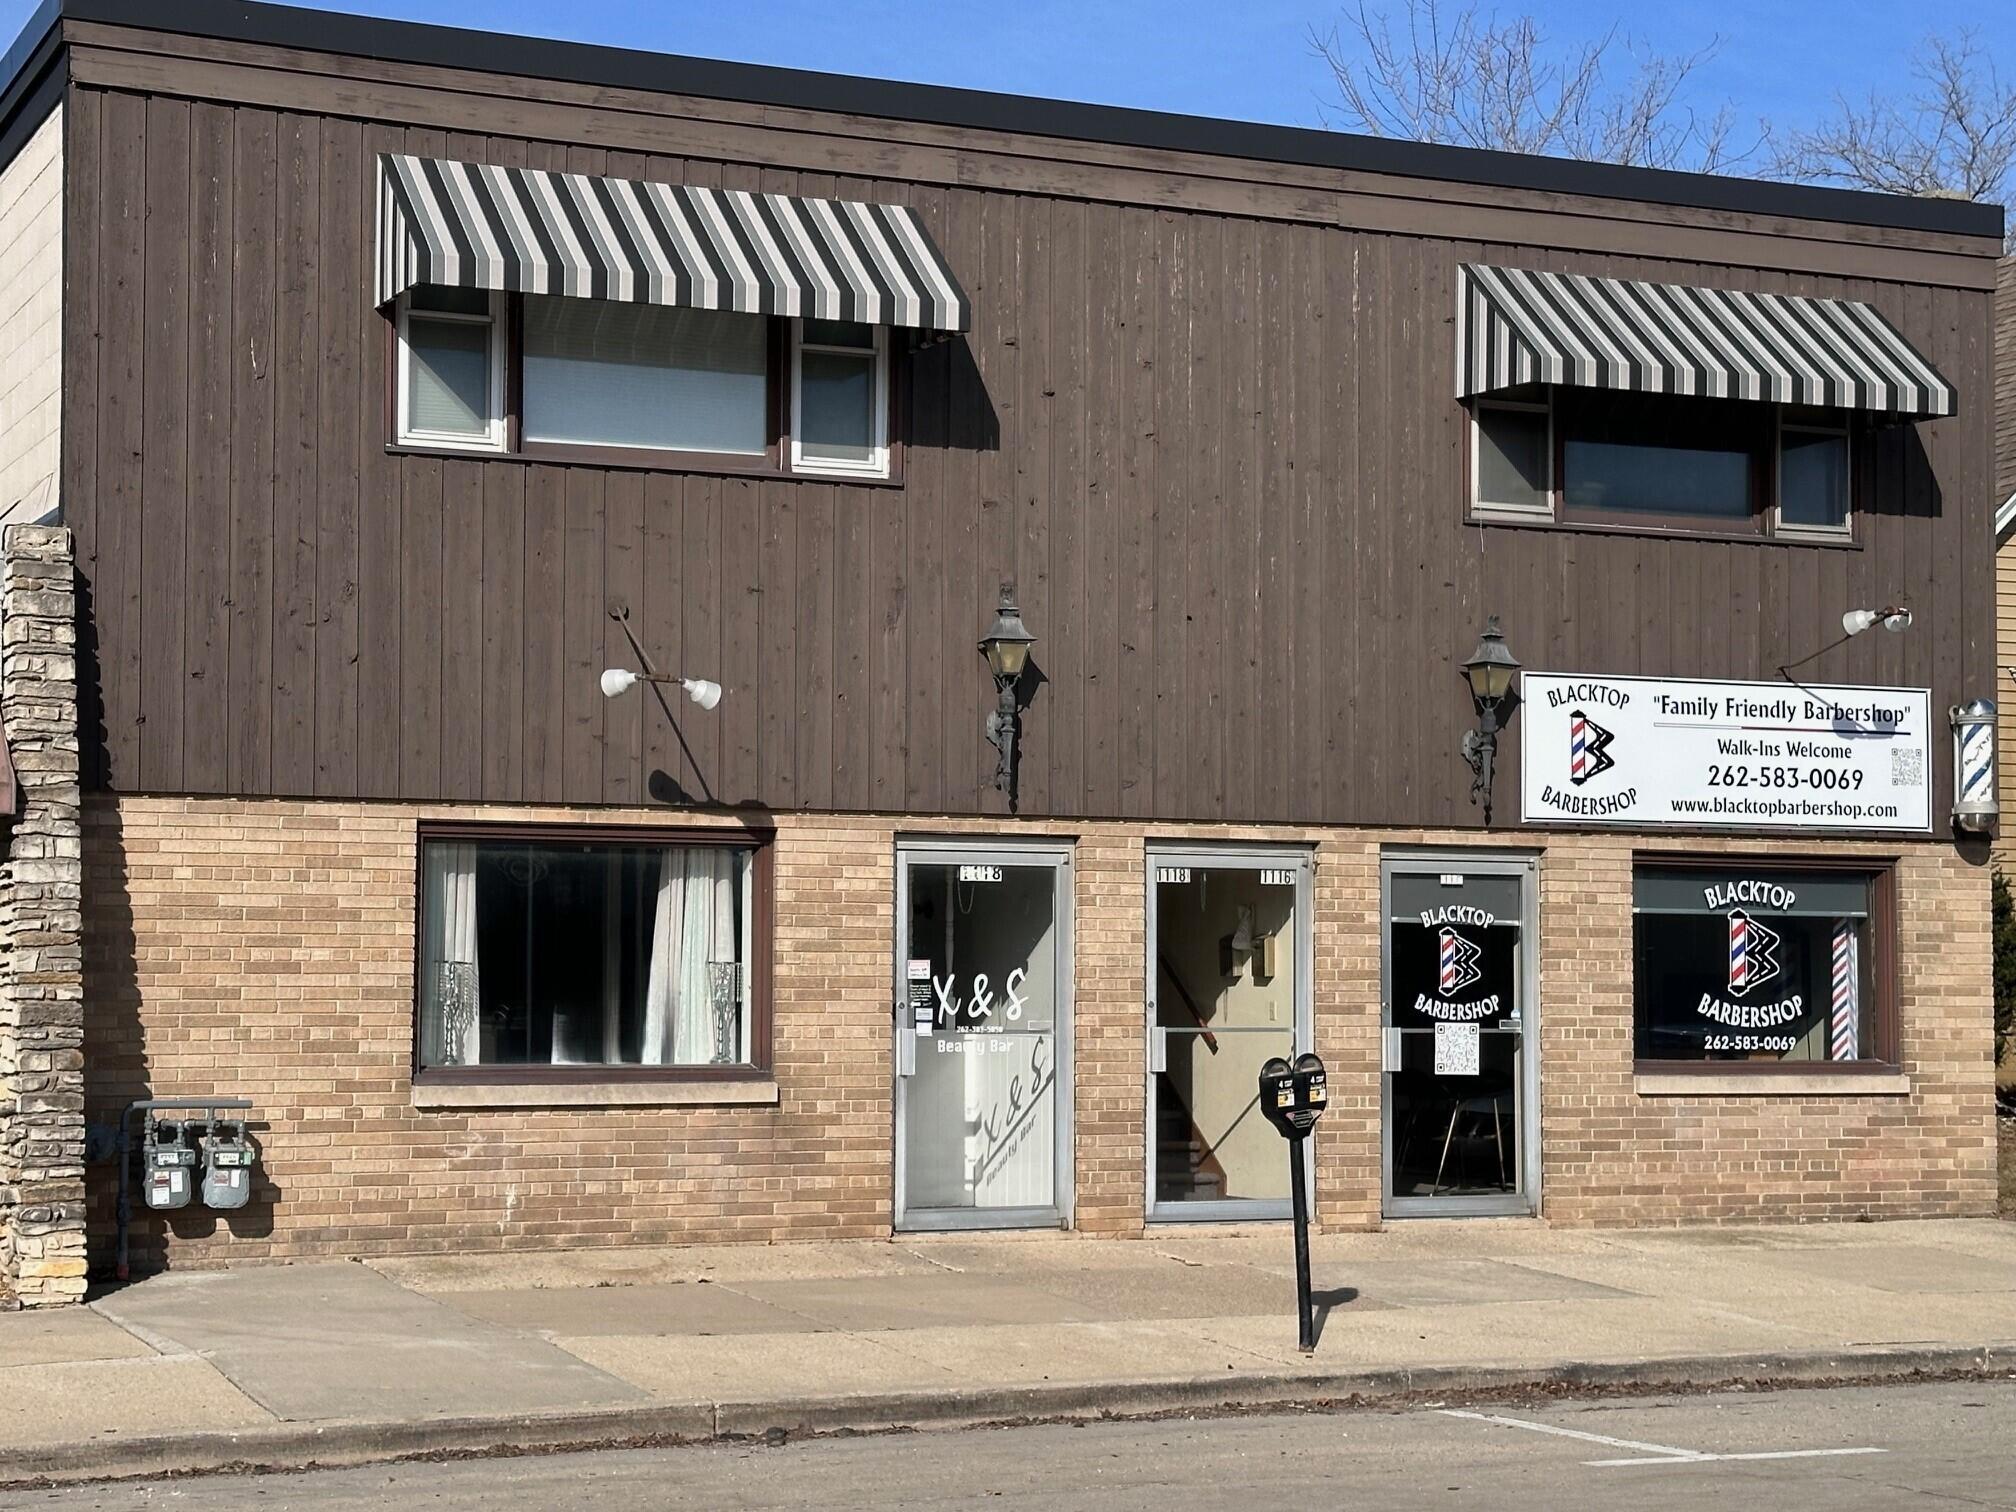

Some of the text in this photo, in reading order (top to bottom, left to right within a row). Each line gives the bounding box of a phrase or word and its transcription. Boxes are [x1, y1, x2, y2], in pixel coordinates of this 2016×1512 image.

[1547, 684, 1630, 710] BLACKTOP
[1653, 695, 1911, 727] "Family Friendly Barbershop"
[1717, 738, 1852, 759] Walk-Ins Welcome
[1707, 764, 1864, 791] 262-583-0069
[1541, 785, 1637, 816] BARBERSHOP
[1671, 797, 1898, 820] www.blacktopbarbershop.com
[1704, 880, 1796, 911] BLACKTOP
[1420, 905, 1495, 930] BLACKTOP
[967, 973, 993, 1020] &
[1414, 993, 1500, 1021] BARBERSHOP
[1697, 993, 1803, 1028] BARBERSHOP
[937, 1039, 1014, 1056] Beay Bar
[1704, 1036, 1796, 1051] 262-583-0069
